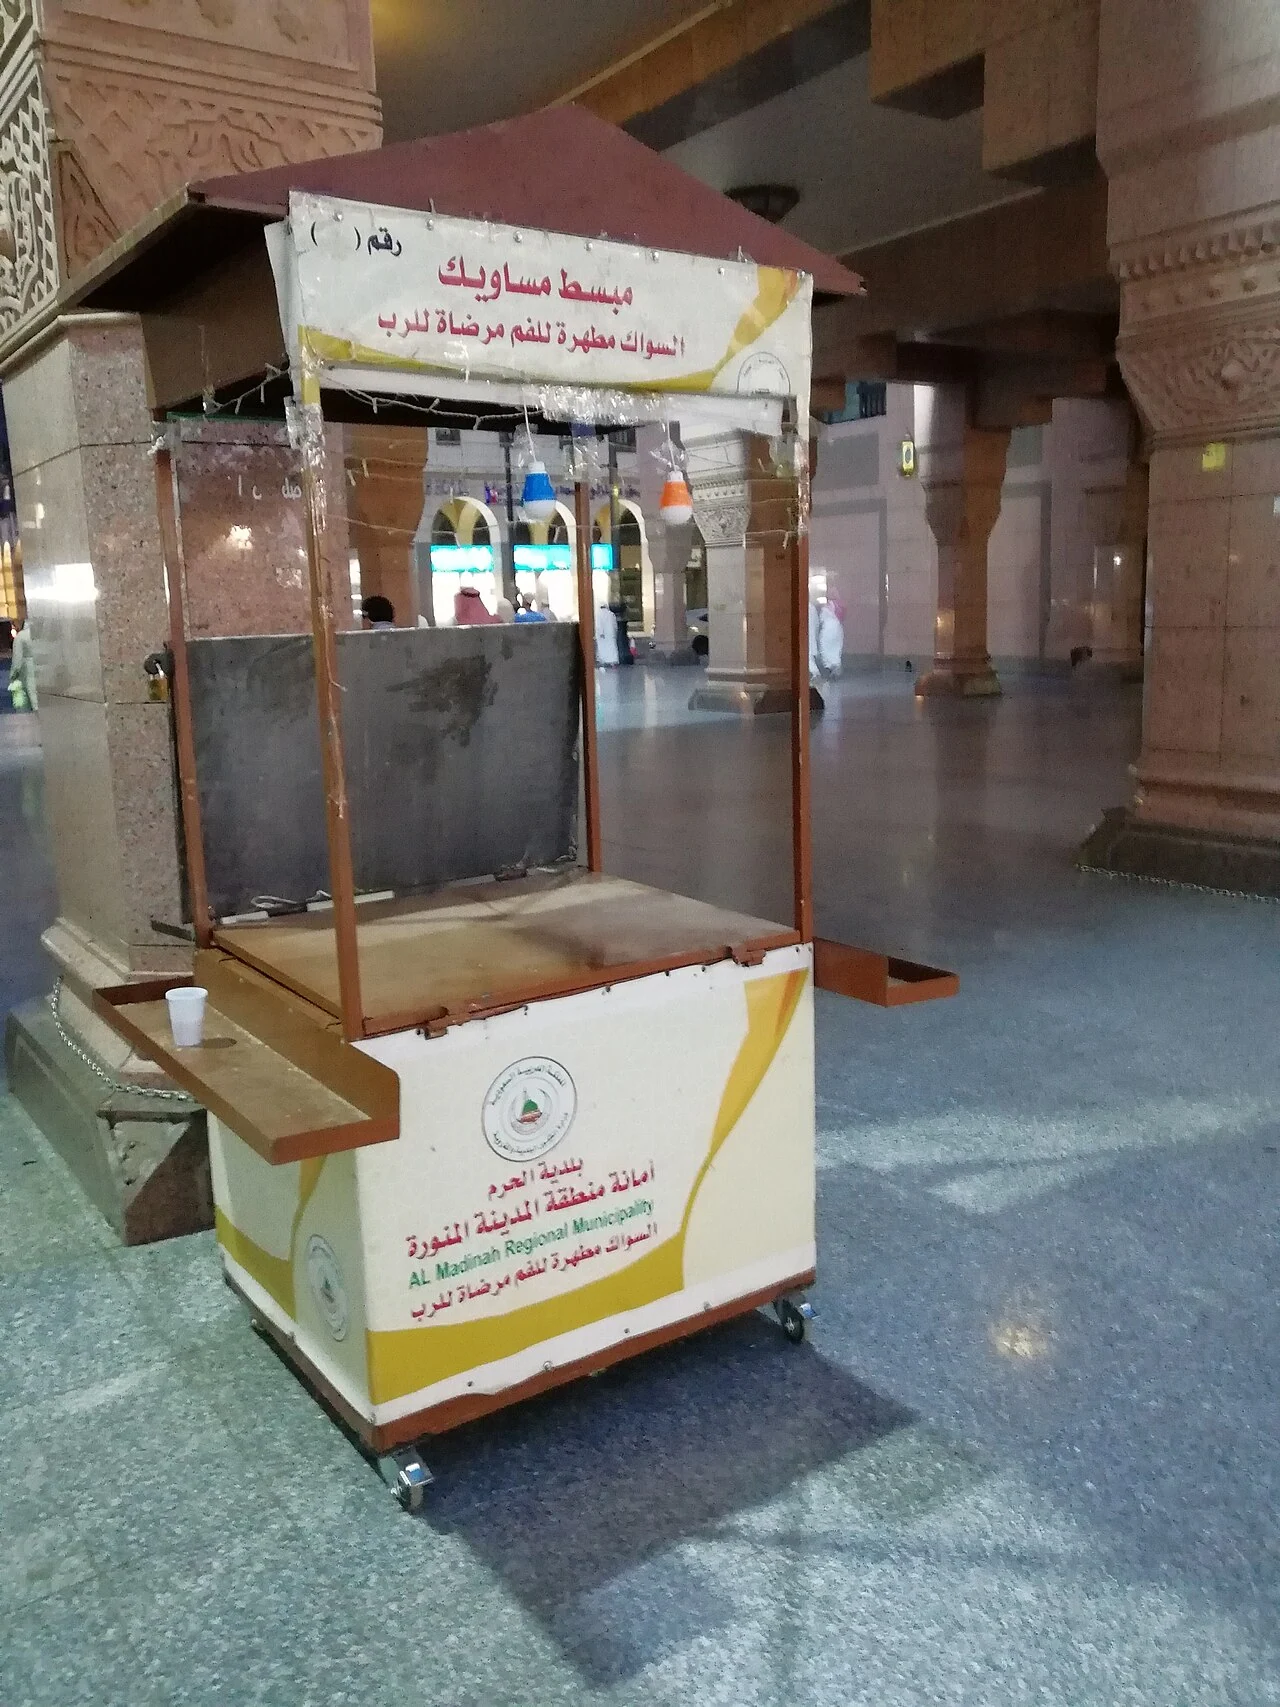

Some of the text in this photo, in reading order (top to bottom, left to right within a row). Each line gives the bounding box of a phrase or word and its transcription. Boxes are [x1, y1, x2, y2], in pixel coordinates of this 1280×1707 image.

[367, 227, 402, 256] رقم
[438, 255, 633, 315] مبسط مساويك
[377, 307, 685, 359] السواك مطهرة للفم مرضاة للرب
[488, 1157, 583, 1200] بلدية الحرم
[405, 1159, 655, 1259] أمانة منطقة المدينة المنورة
[408, 1198, 655, 1289] AL Madinah Regional Municipality
[411, 1222, 658, 1322] السواك مطهرة للفم مرضاة للرب
